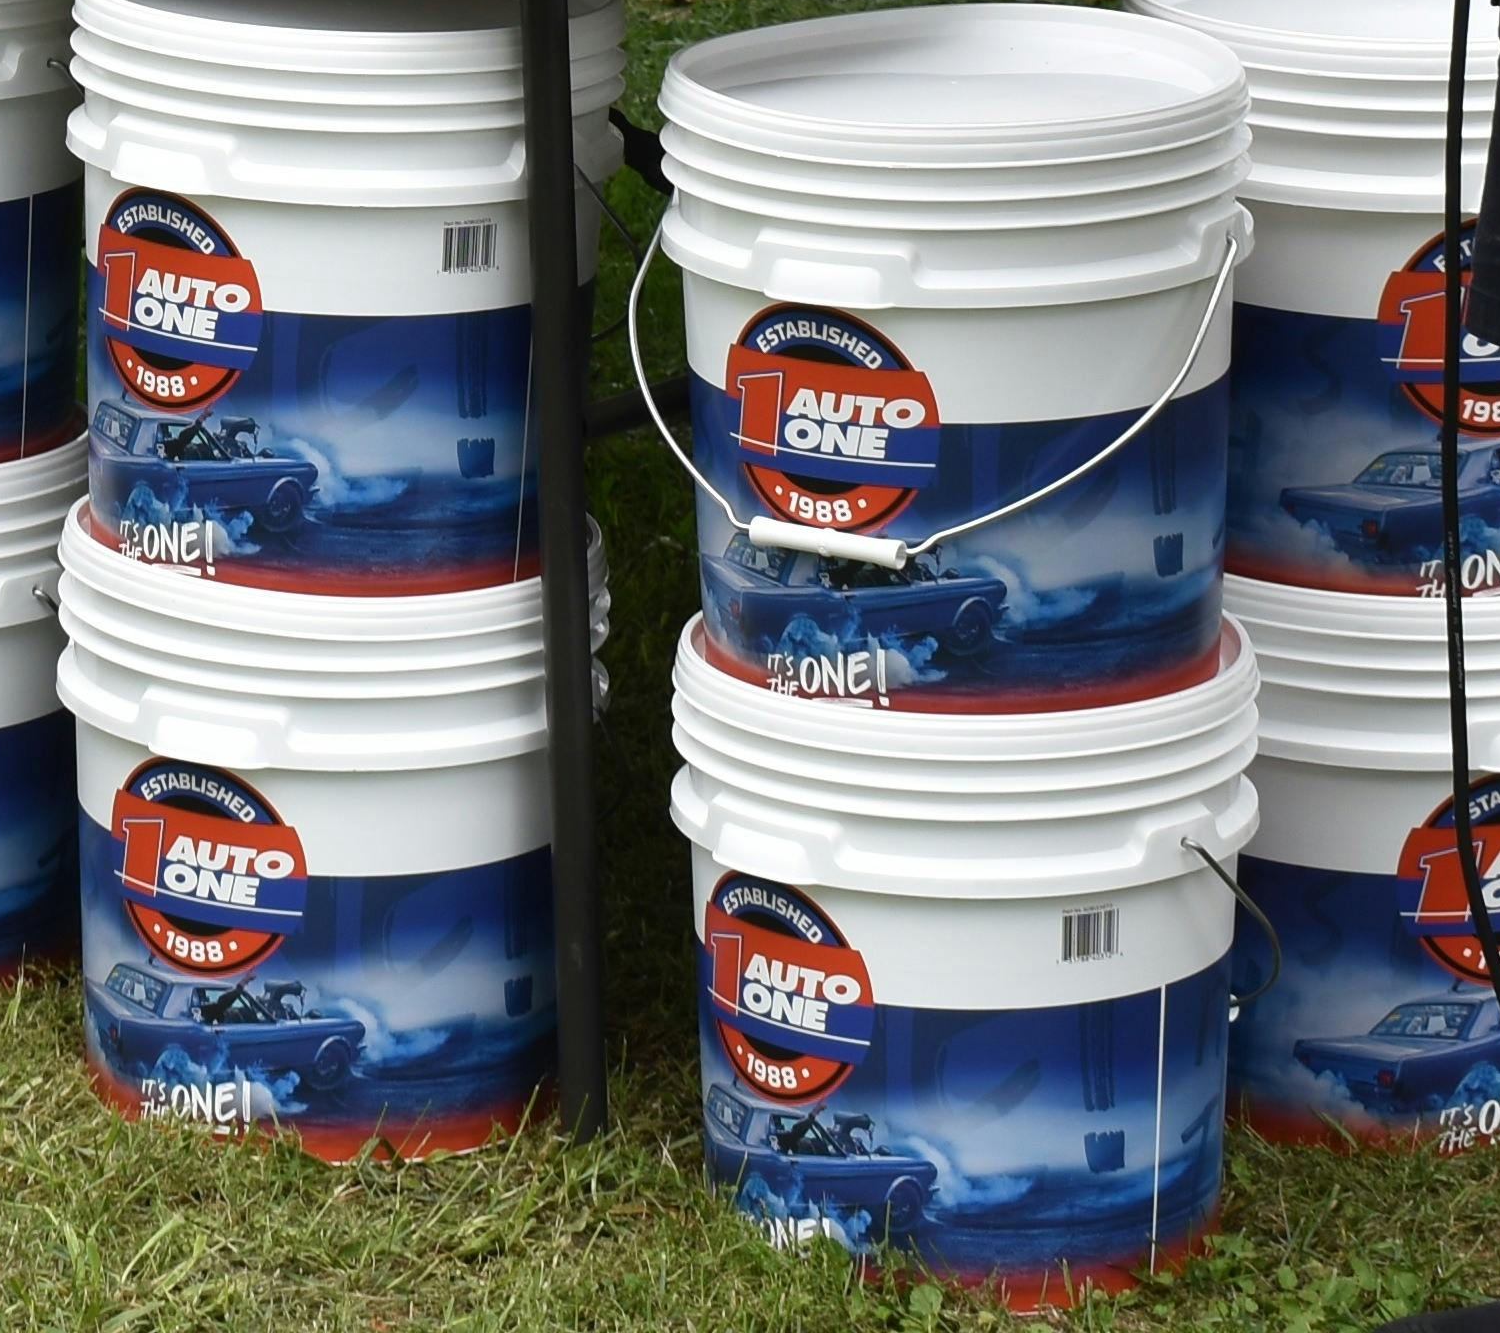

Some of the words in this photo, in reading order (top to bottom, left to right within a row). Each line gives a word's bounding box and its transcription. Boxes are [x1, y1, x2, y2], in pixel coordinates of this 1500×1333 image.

[116, 205, 215, 255] ESTABLISHED
[137, 268, 251, 313] AUTO
[134, 297, 219, 340] ONE
[755, 319, 882, 370] ESTABLISHED
[136, 365, 185, 397] 1988
[786, 387, 926, 429] AUTO
[784, 418, 889, 460] ONE
[788, 490, 853, 524] 1988
[119, 519, 140, 542] IT'S
[143, 519, 215, 576] ONE!
[119, 542, 142, 562] THE
[767, 651, 794, 676] IT'S
[800, 649, 889, 707] ONE!
[766, 677, 799, 697] THE
[140, 772, 256, 824] ESTABLISHED
[165, 835, 295, 879] AUTO
[164, 865, 260, 906] ONE
[723, 885, 823, 944] ESTABLISHED
[165, 930, 223, 963] 1988
[744, 952, 862, 1006] AUTO
